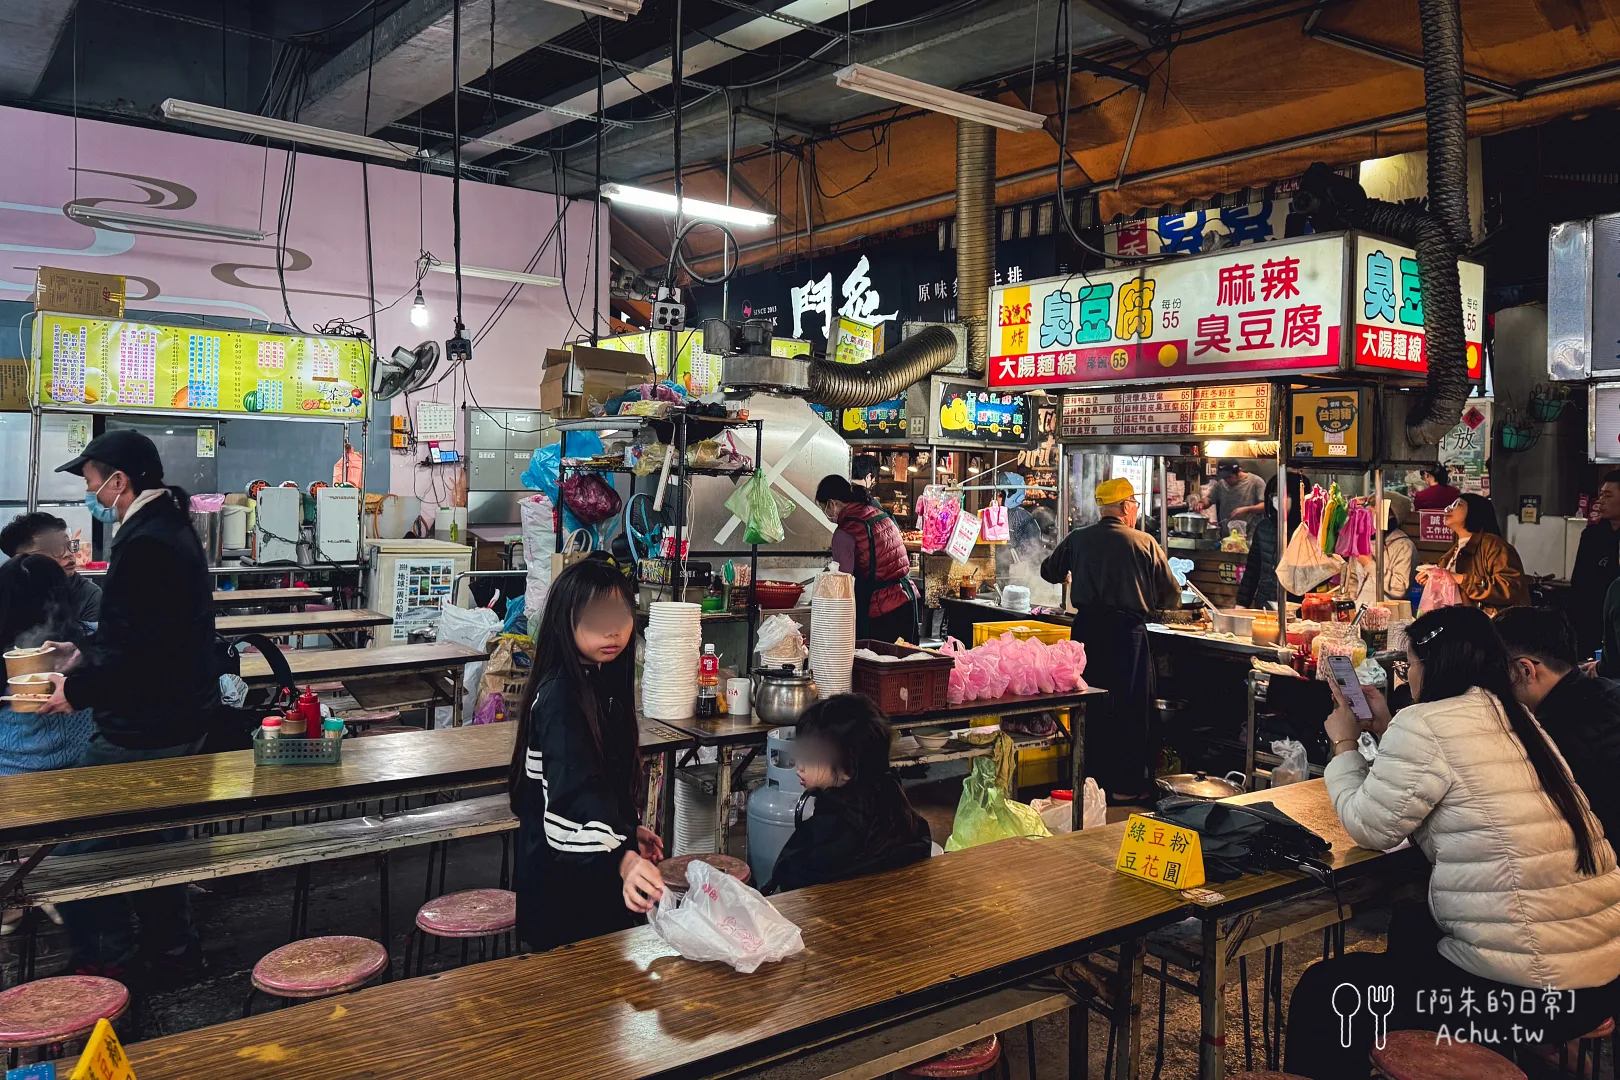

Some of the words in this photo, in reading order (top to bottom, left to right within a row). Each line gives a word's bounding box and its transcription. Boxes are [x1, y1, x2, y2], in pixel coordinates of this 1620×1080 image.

[1217, 256, 1301, 307] 麻辣
[1162, 298, 1182, 310] 每份
[1040, 277, 1156, 349] 臭豆腐
[1162, 311, 1180, 328] 55
[1467, 313, 1476, 331] 55
[1194, 303, 1322, 356] 臭豆腐
[1011, 329, 1024, 348] 炸
[1362, 328, 1422, 363] 大腸麵線
[999, 352, 1076, 380] 大腸麵線
[1112, 352, 1128, 368] 55
[1181, 391, 1190, 399] 65
[1256, 387, 1265, 396] 85
[1180, 402, 1188, 410] 65
[1256, 399, 1265, 407] 85
[1180, 413, 1188, 421] 85
[1255, 410, 1264, 419] 85
[1180, 424, 1188, 432] 85
[1252, 422, 1264, 430] 100
